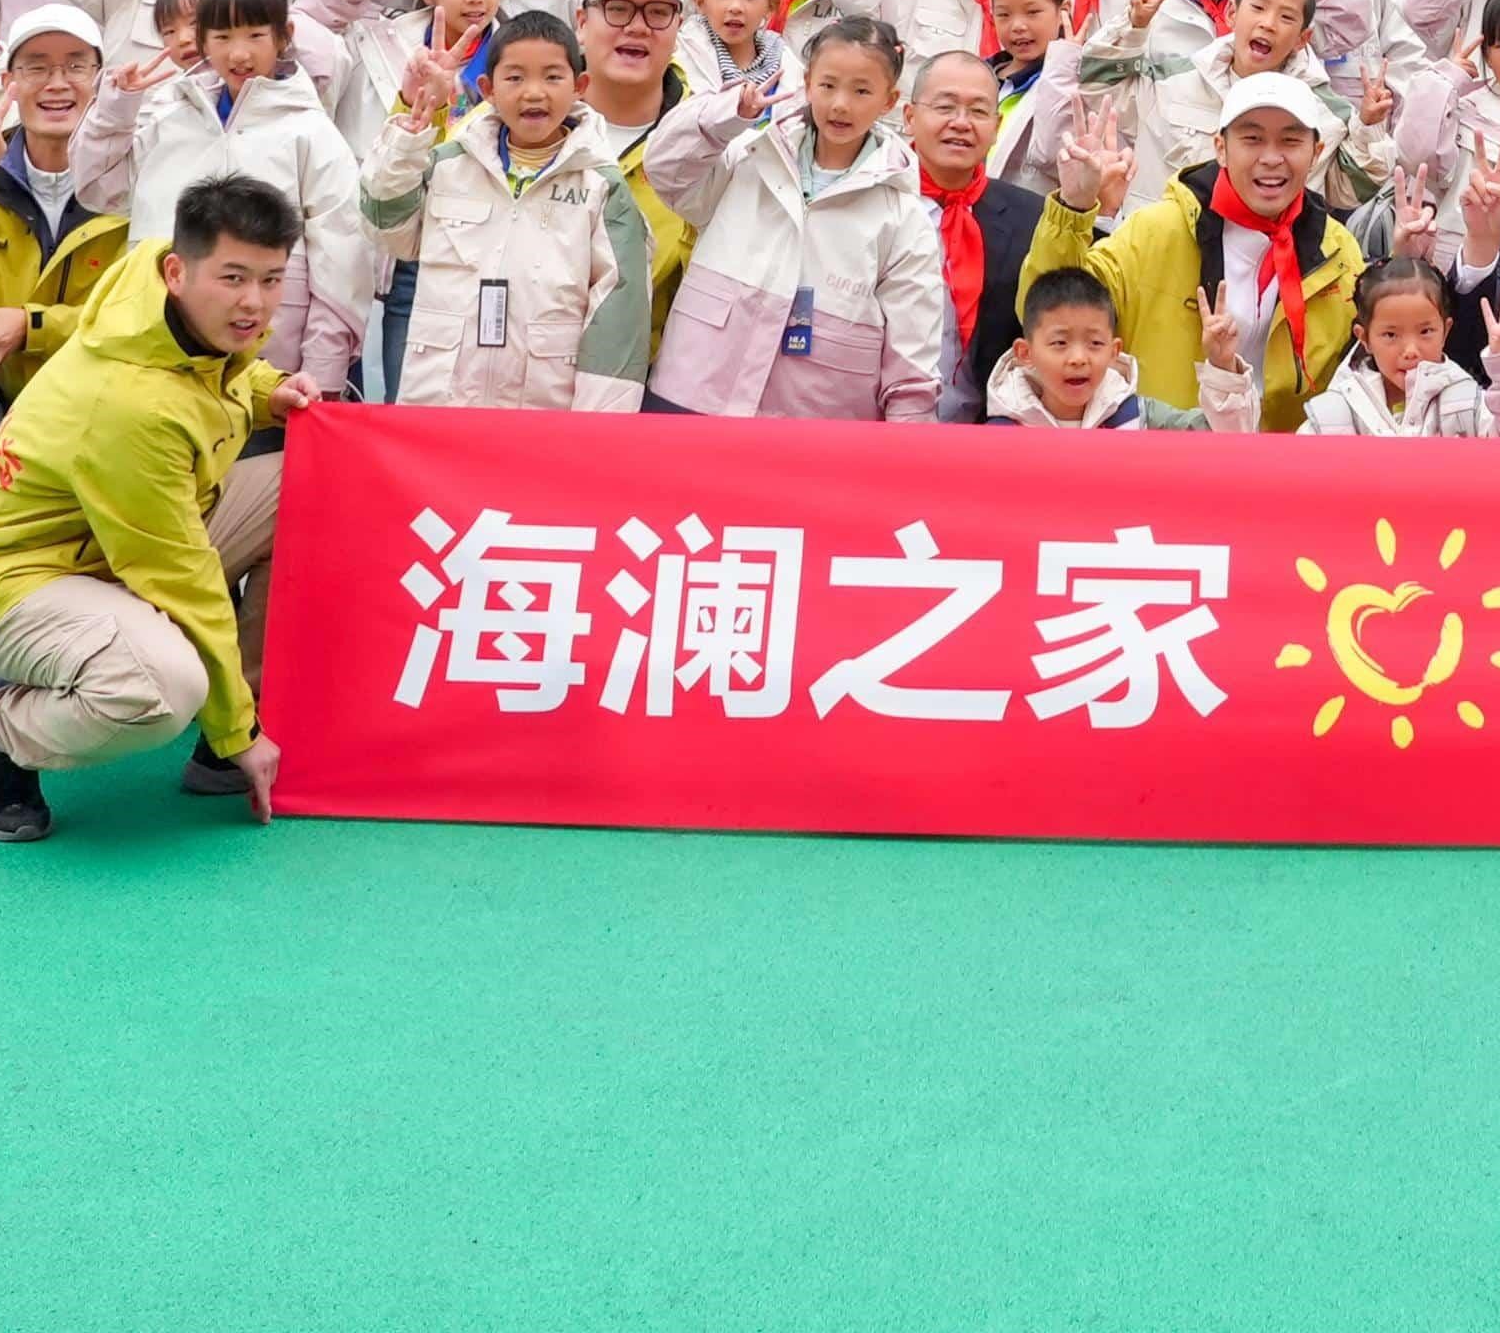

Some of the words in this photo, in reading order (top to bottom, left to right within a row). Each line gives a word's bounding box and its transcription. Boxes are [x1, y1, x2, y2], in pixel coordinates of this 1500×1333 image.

[550, 184, 590, 206] LAN
[394, 507, 1231, 729] 海澜之家
